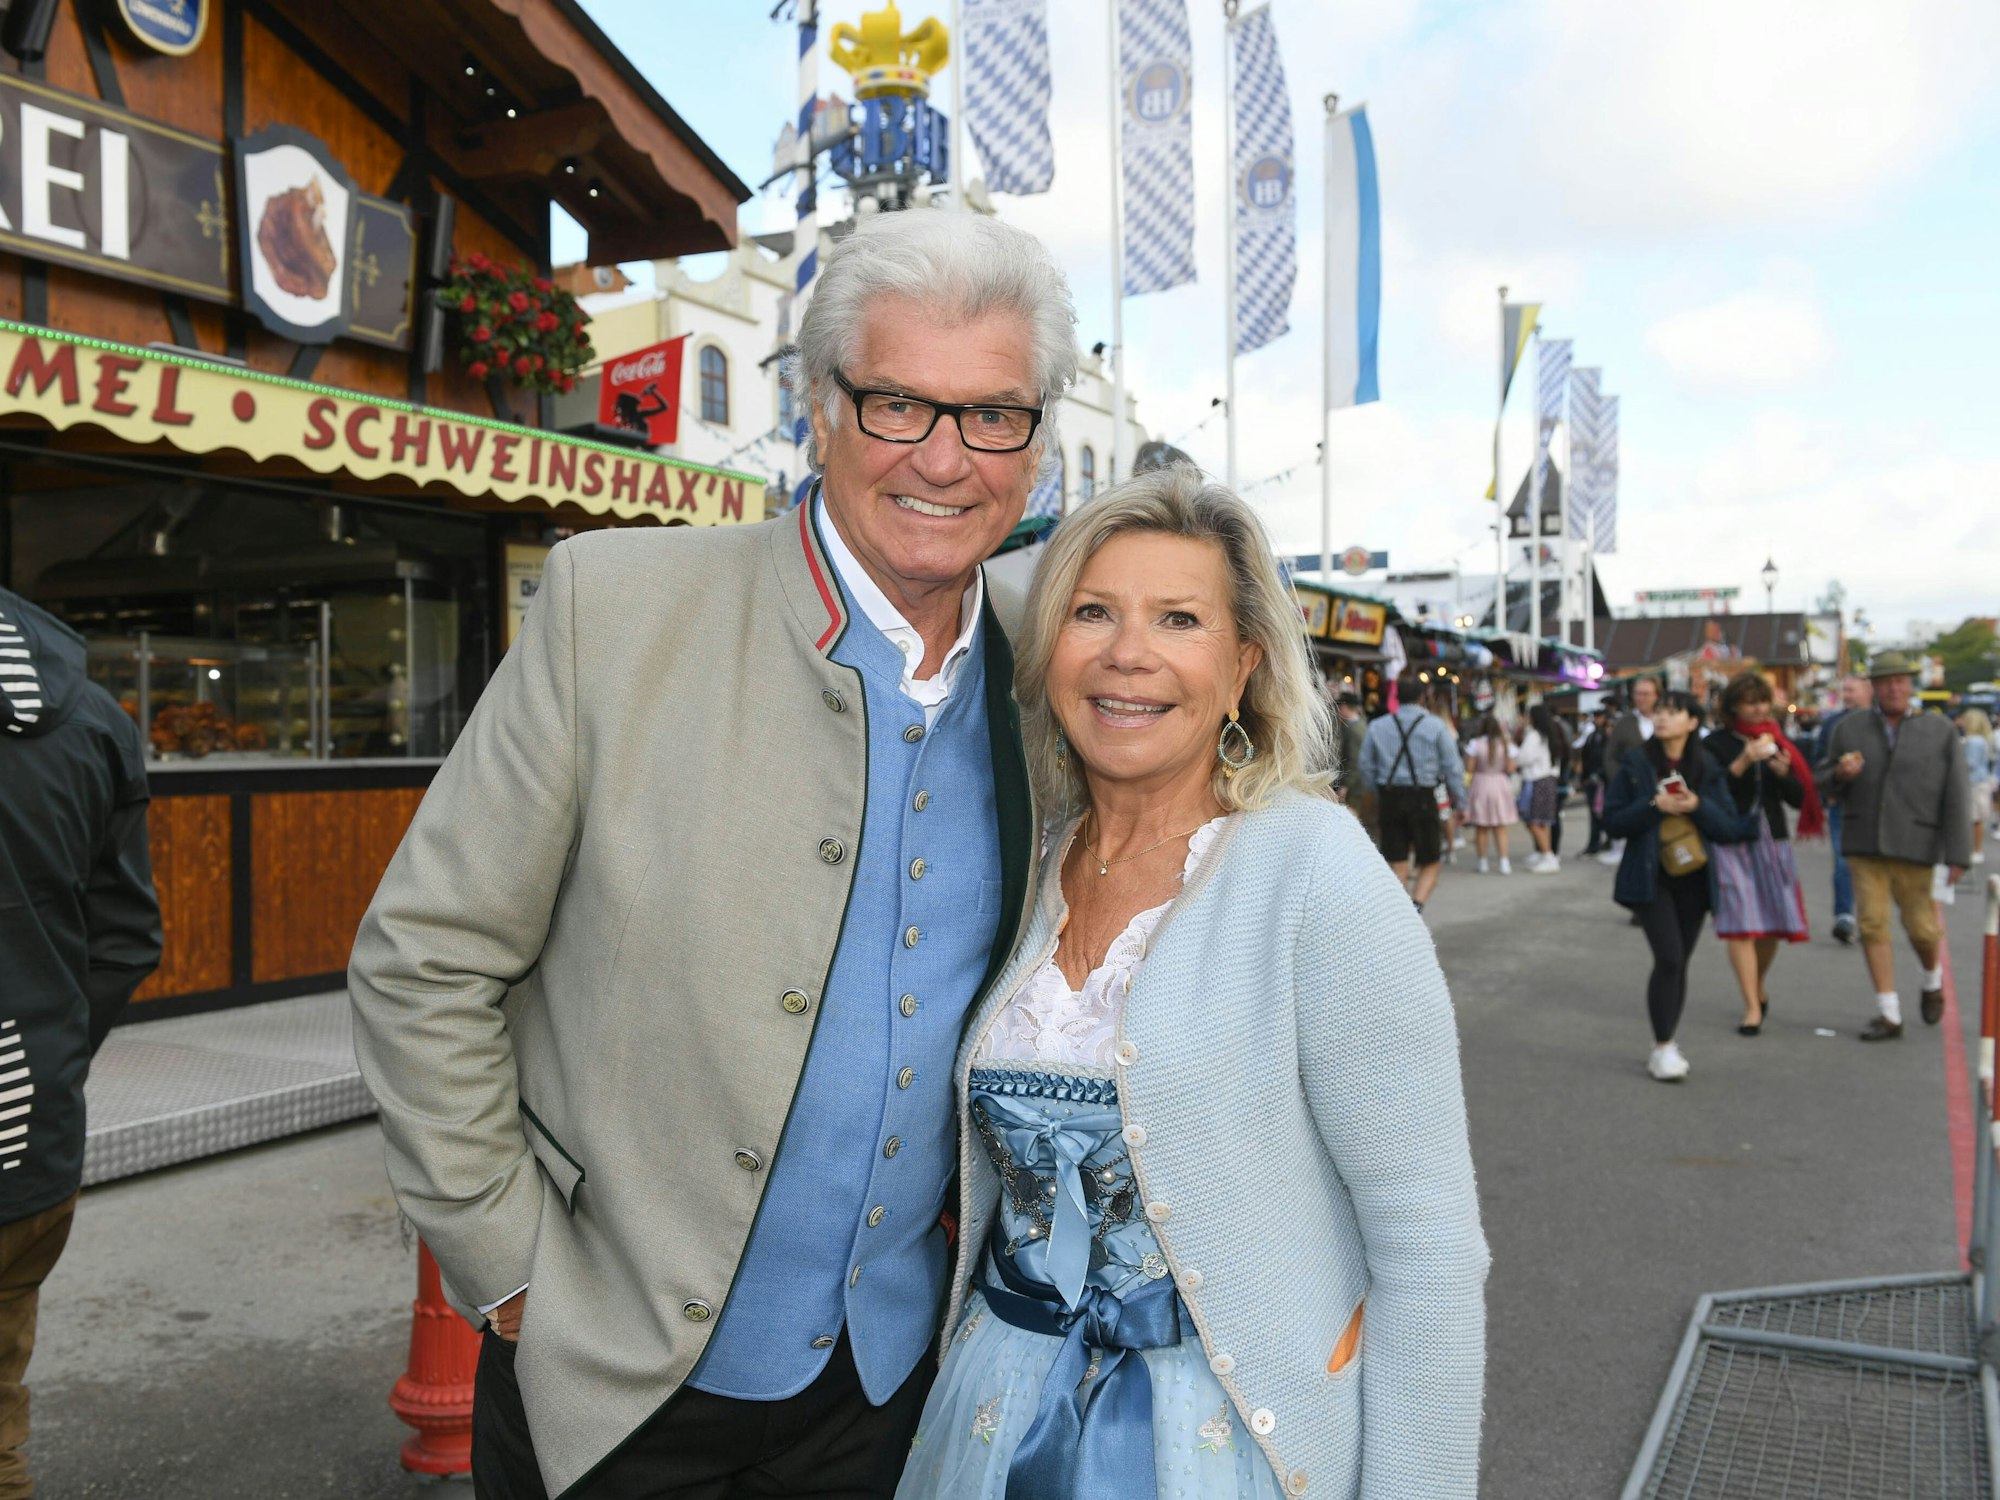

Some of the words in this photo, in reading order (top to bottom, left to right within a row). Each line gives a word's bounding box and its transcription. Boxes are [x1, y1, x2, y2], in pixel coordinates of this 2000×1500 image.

[0, 102, 131, 261] EI
[5, 336, 195, 427] MEL
[303, 396, 745, 522] SCHWEINSHAX'N
